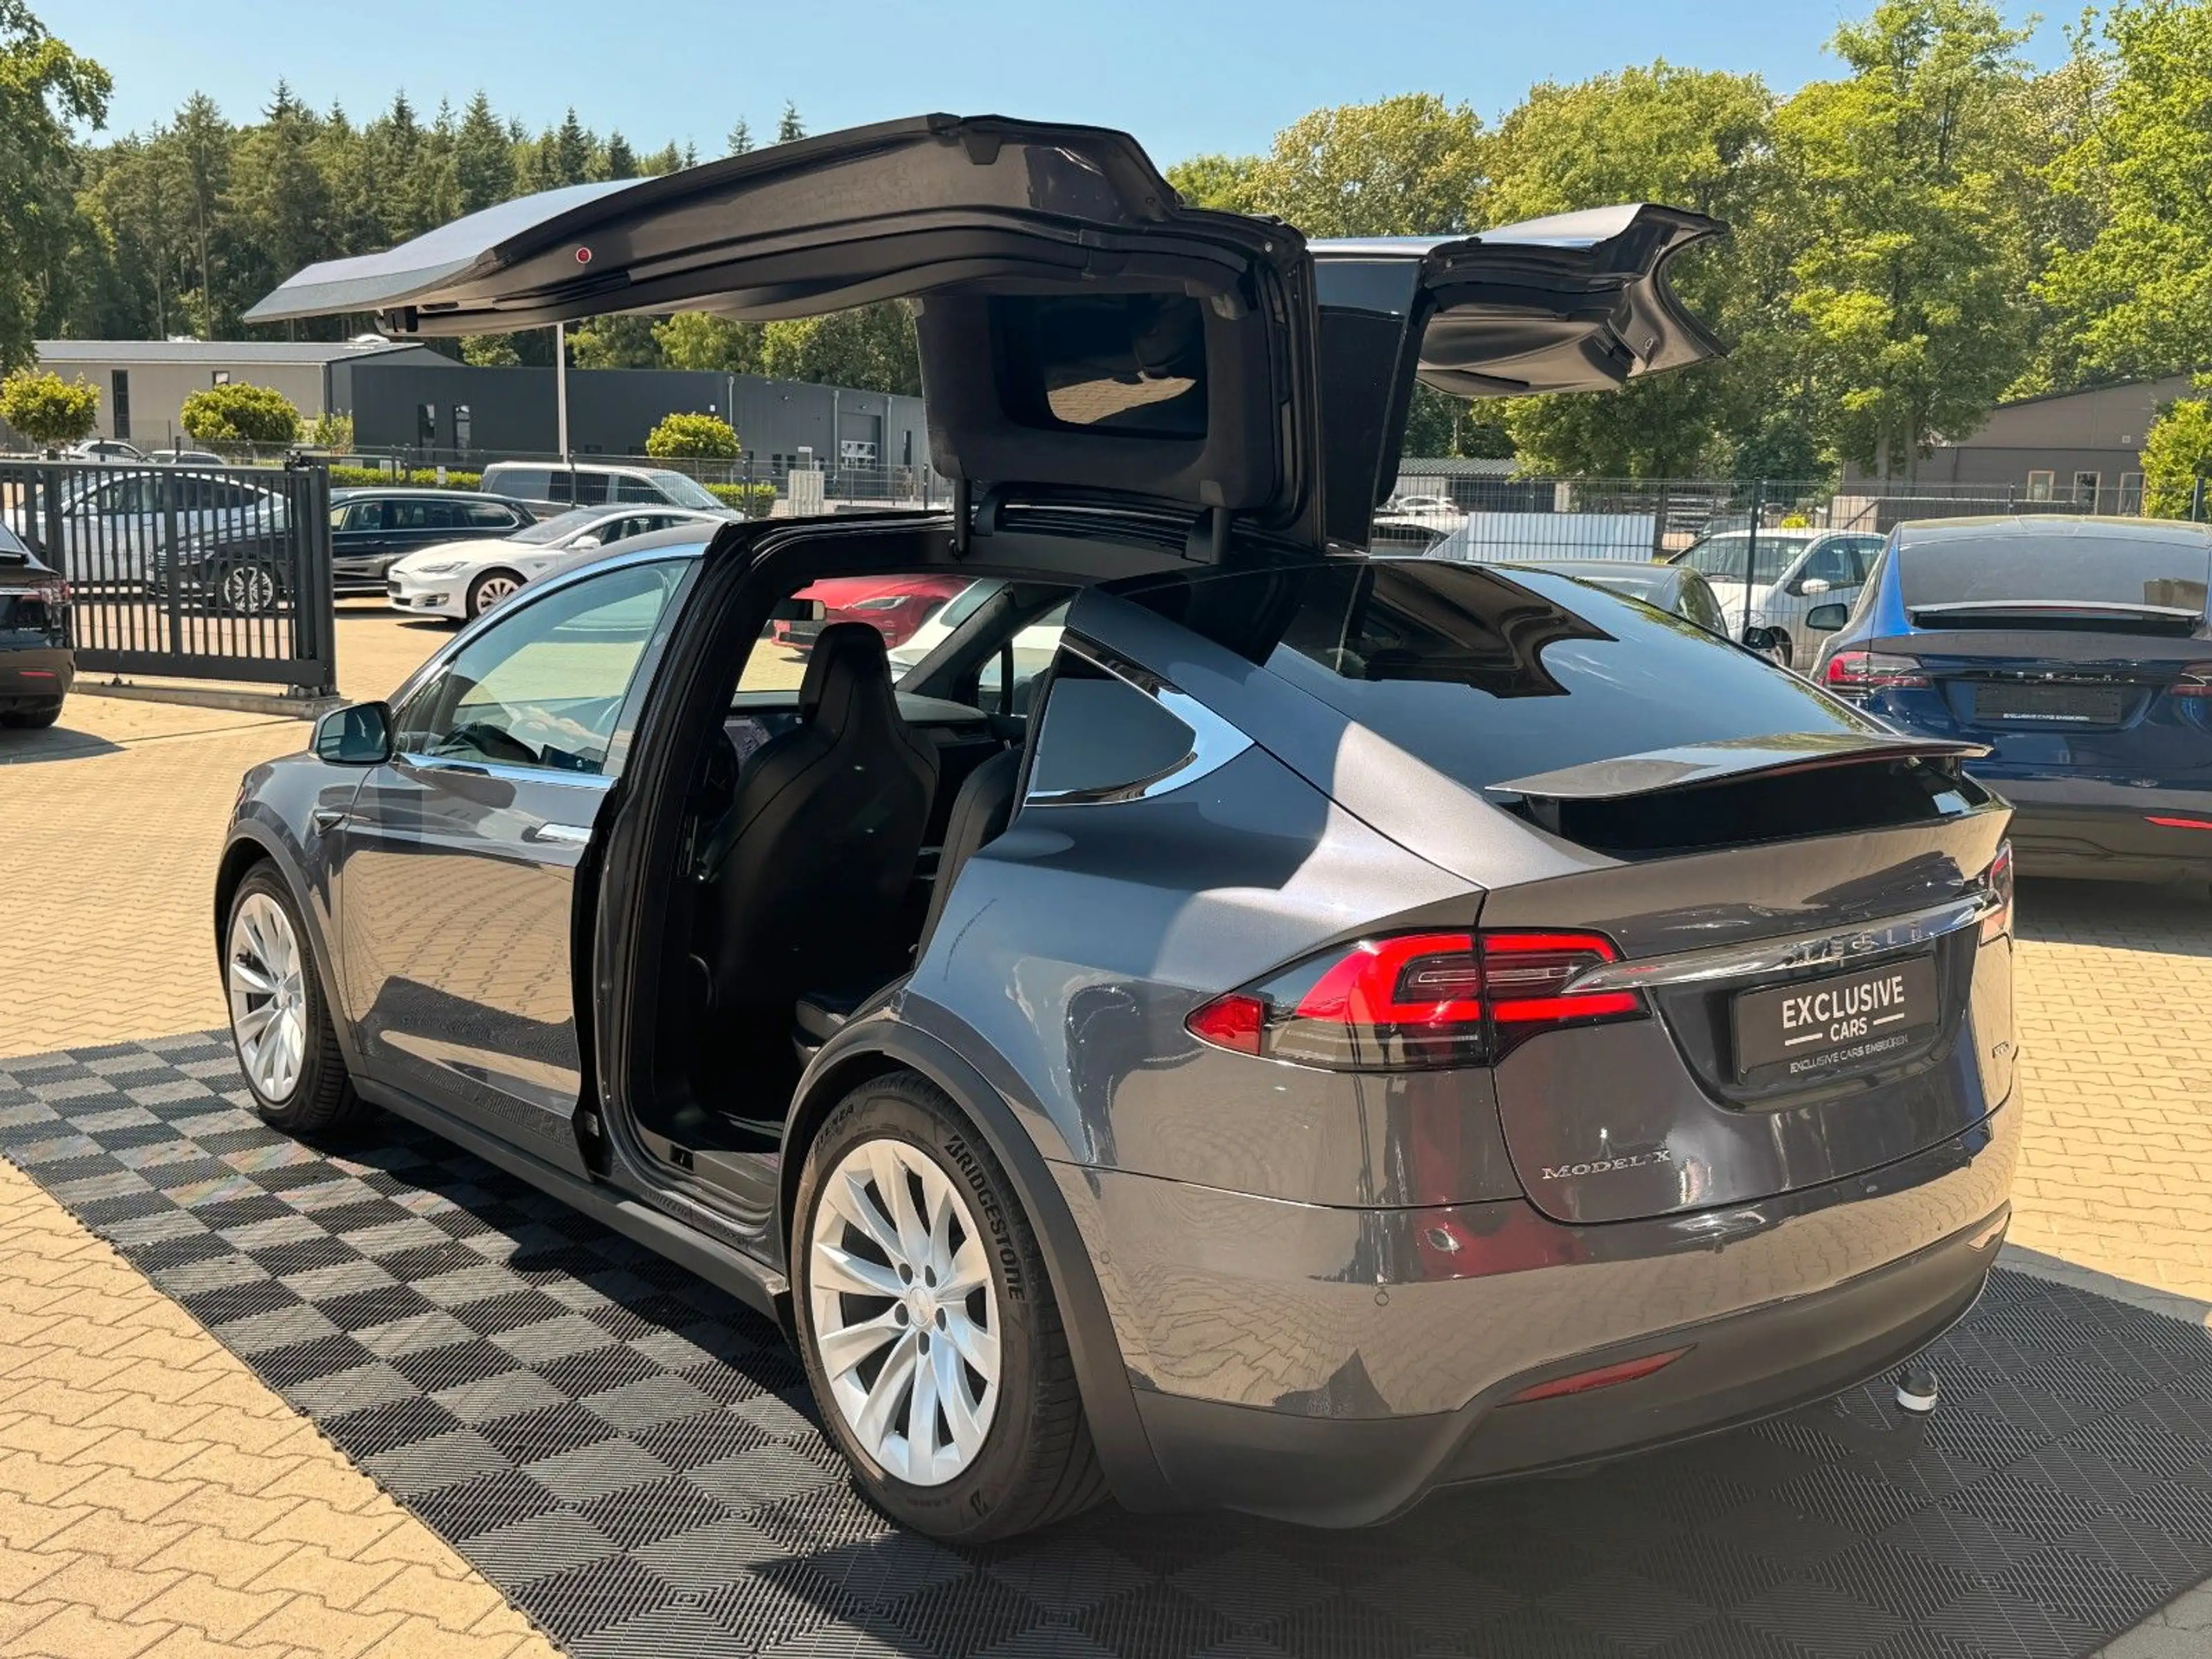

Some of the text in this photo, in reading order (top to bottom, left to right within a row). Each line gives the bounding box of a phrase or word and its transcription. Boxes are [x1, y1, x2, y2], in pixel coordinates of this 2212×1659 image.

[1782, 976, 1905, 1029] EXCLUSIVE
[1830, 1017, 1868, 1042] CARS
[1790, 1052, 1839, 1074] EXCLUSIVE
[1839, 1045, 1864, 1060] CARS
[1541, 1149, 1671, 1180] MODEL X
[944, 1135, 1025, 1301] BRIDGESTONE
